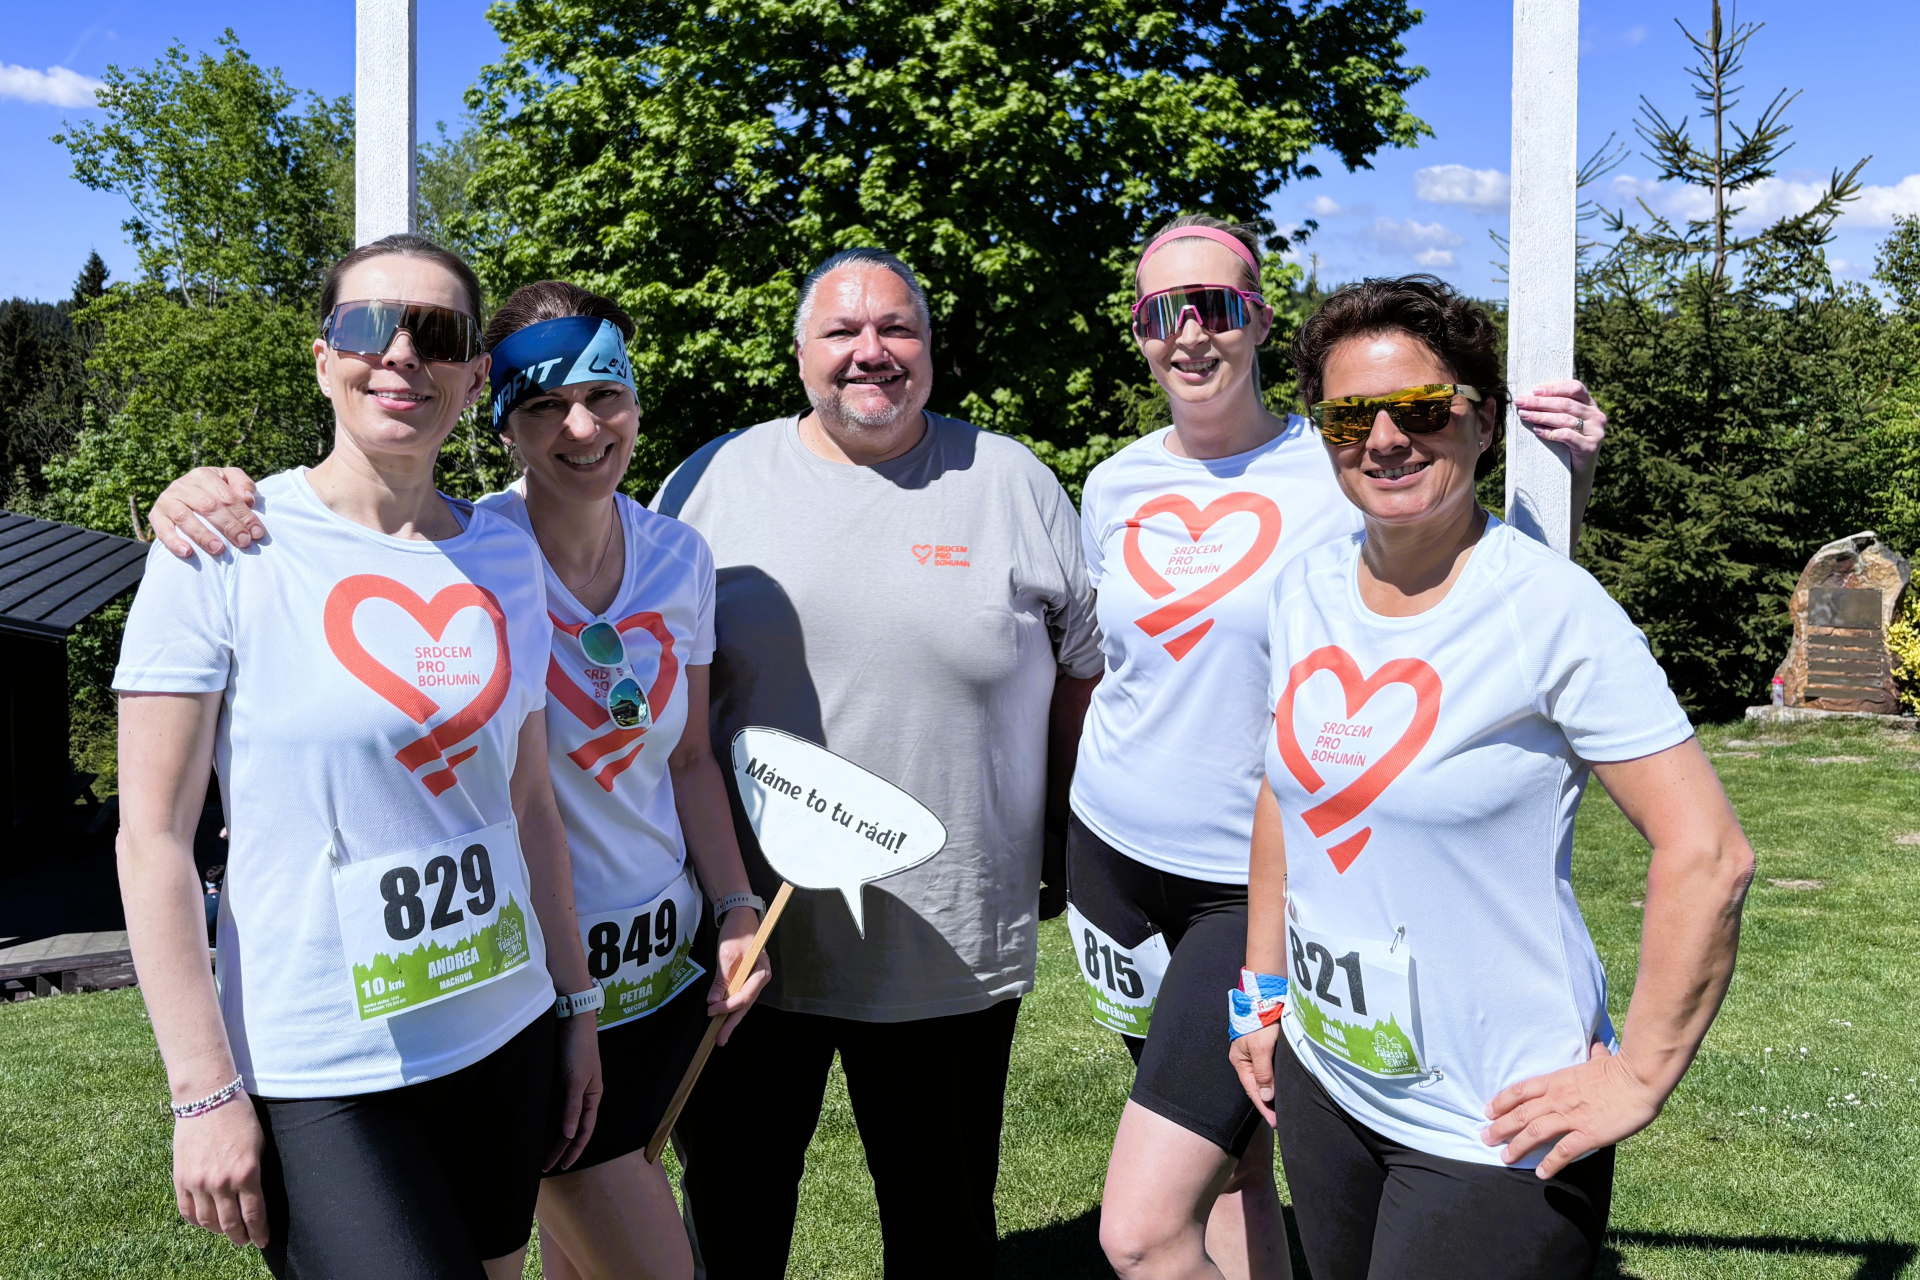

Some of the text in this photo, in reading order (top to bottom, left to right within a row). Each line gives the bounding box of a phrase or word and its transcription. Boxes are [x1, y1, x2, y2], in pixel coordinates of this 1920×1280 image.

[935, 545, 968, 553] SRDCEM
[1172, 544, 1223, 555] SRDCEM
[934, 559, 971, 567] BOHUMÍN
[1164, 563, 1221, 576] BOHUMÍN
[1168, 556, 1194, 566] PRO
[414, 646, 472, 659] SRDCEM
[416, 660, 446, 673] PRO
[418, 670, 481, 687] BOHUMÍN
[1320, 721, 1373, 738] SRDCEM
[1315, 735, 1341, 750] PRO
[1311, 749, 1367, 767] BOHUMÍN
[744, 757, 908, 855] Máme to tu rádi!
[379, 843, 496, 941] 829
[587, 898, 677, 980] 849
[428, 946, 480, 980] ANDREA
[1084, 927, 1144, 999] 815
[1289, 925, 1368, 1016] 821
[361, 976, 406, 999] 10 km
[440, 969, 473, 990] MACHOVÁ
[619, 983, 653, 1006] PETRA
[1096, 997, 1138, 1025] KATEŘINA
[1321, 1020, 1347, 1045] JANA
